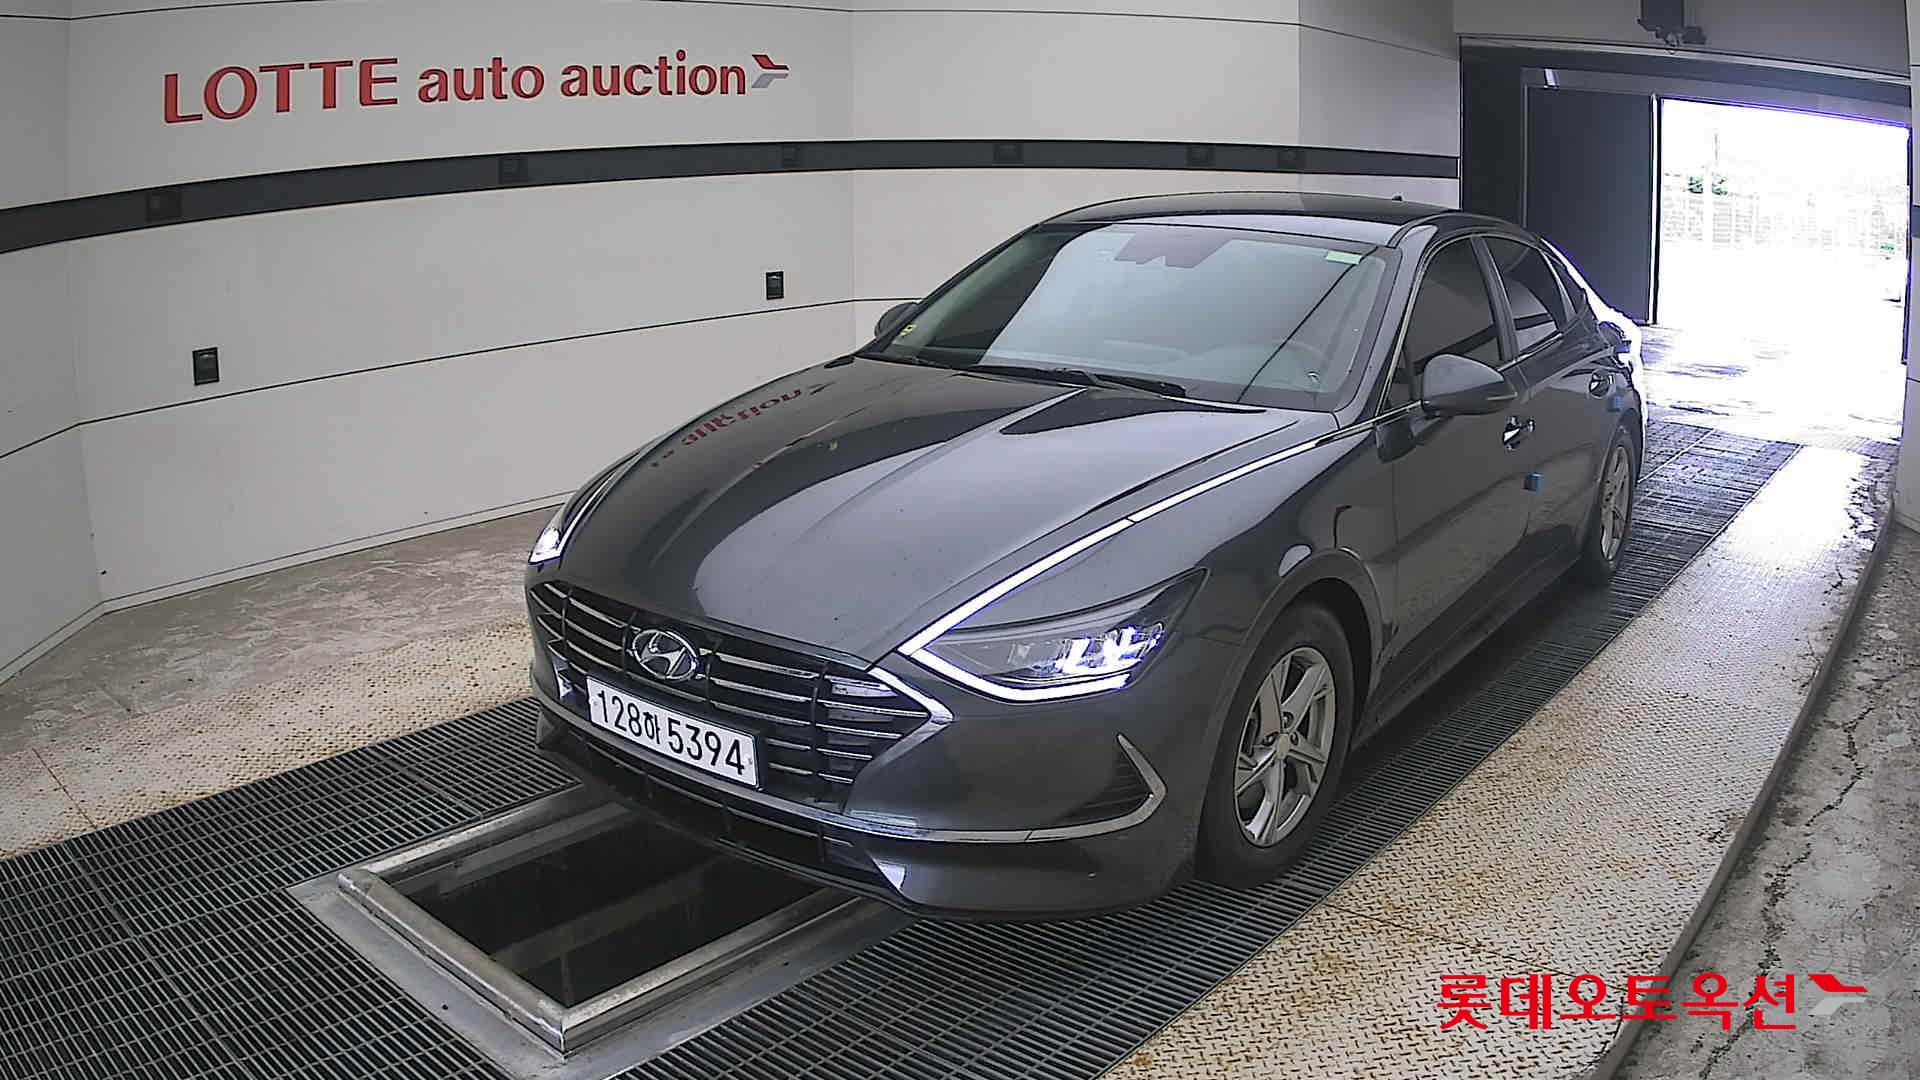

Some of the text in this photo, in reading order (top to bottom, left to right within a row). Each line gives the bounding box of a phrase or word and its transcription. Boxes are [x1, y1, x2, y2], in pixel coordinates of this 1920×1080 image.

[164, 50, 746, 124] LOTTE auto auction
[667, 717, 745, 775] 5394
